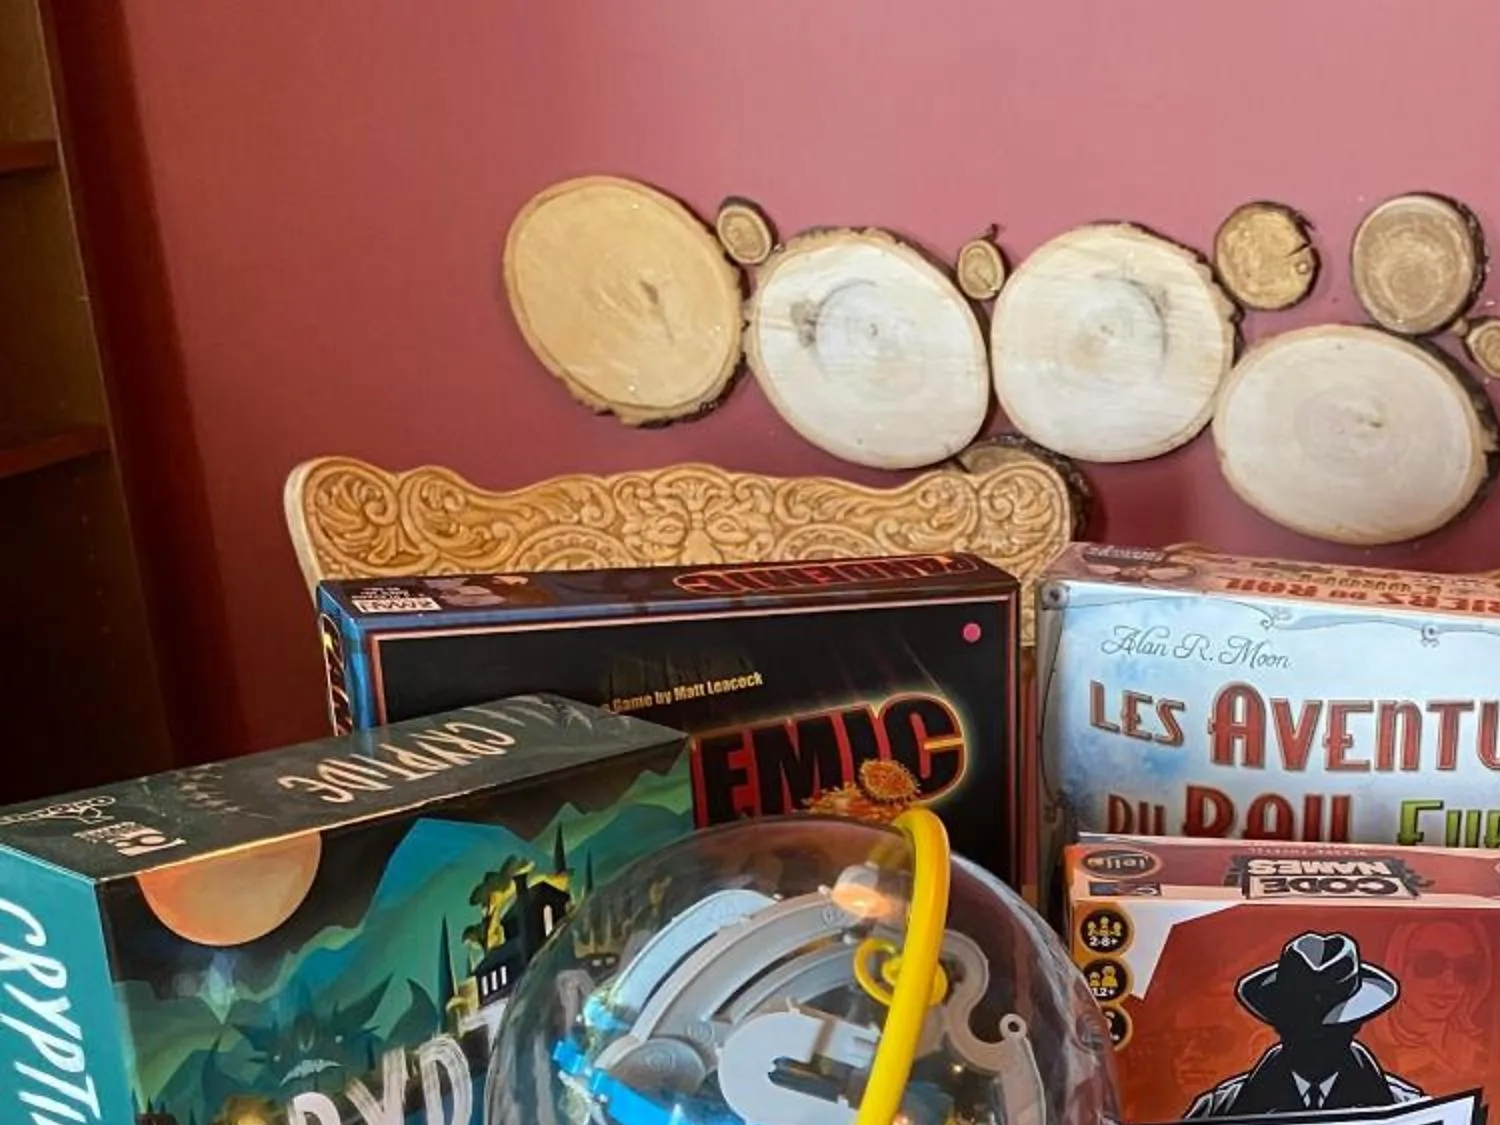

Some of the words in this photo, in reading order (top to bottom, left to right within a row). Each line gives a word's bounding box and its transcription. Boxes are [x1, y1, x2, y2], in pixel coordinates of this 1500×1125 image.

[1101, 624, 1171, 657] Alan
[1172, 632, 1214, 662] R.
[1218, 634, 1291, 669] Moon
[654, 689, 672, 706] by
[673, 681, 706, 703] Matt
[706, 671, 763, 696] Leacock
[1088, 679, 1187, 748] LES
[277, 720, 517, 804] CRYPTIDE
[1246, 859, 1392, 877] NAMES
[1258, 877, 1399, 895] CODE
